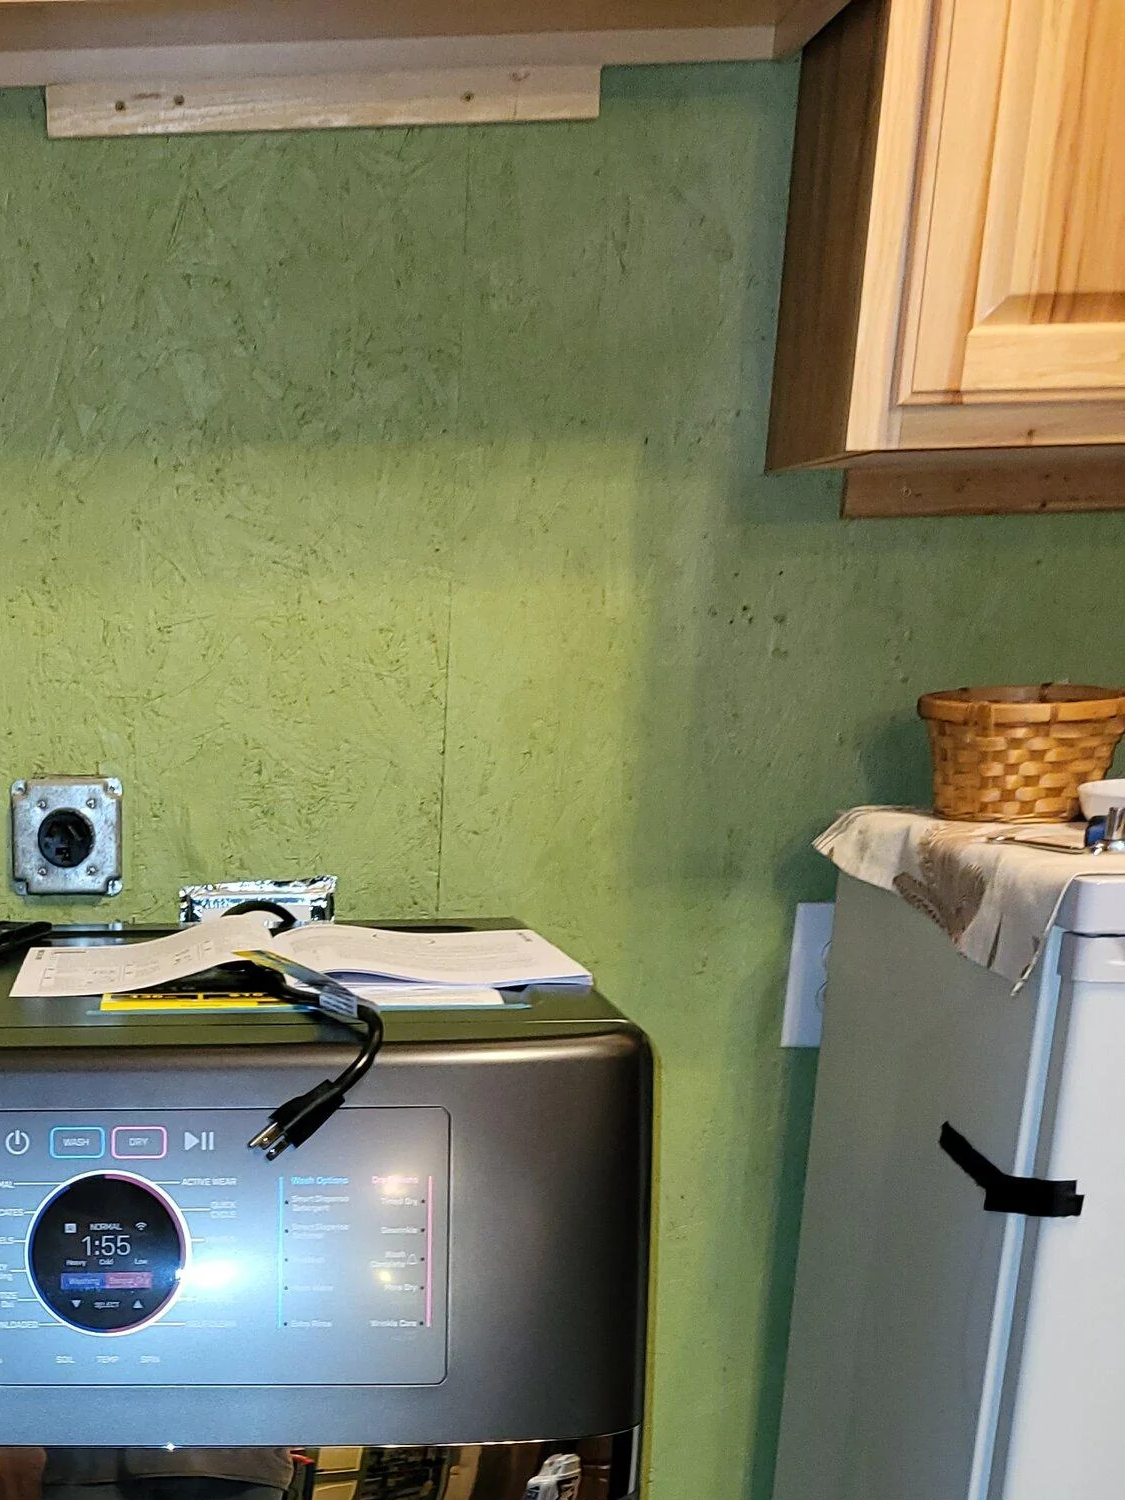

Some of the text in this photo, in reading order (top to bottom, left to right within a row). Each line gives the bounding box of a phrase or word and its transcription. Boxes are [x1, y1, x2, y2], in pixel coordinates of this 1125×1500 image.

[63, 1137, 149, 1147] WASH DRY
[89, 1223, 123, 1231] NORMAL
[82, 1235, 131, 1256] 1:55
